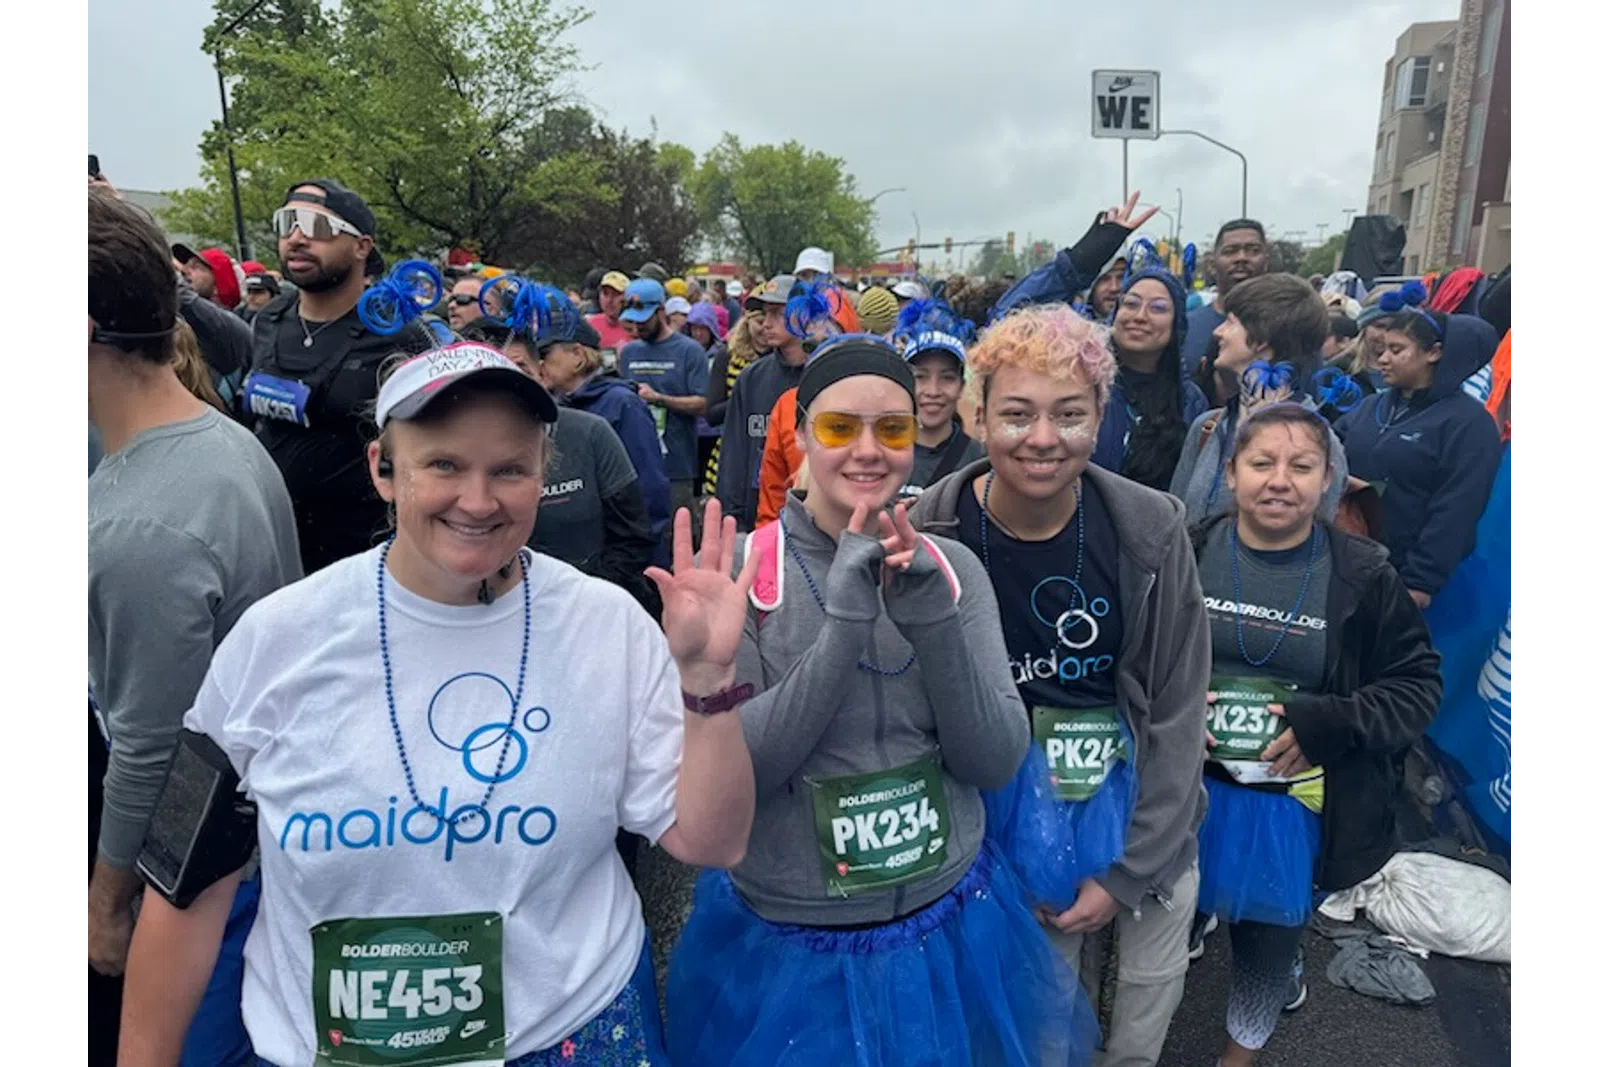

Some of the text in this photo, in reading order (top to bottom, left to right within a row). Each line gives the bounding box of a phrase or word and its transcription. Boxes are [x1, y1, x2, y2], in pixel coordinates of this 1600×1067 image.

[1097, 95, 1151, 129] WE
[1009, 648, 1114, 685] aidpro
[1205, 704, 1280, 734] PK237
[280, 786, 557, 862] maidpro
[831, 796, 939, 855] PK234
[341, 940, 470, 958] BOLDERBOULDER
[329, 964, 484, 1020] NE453
